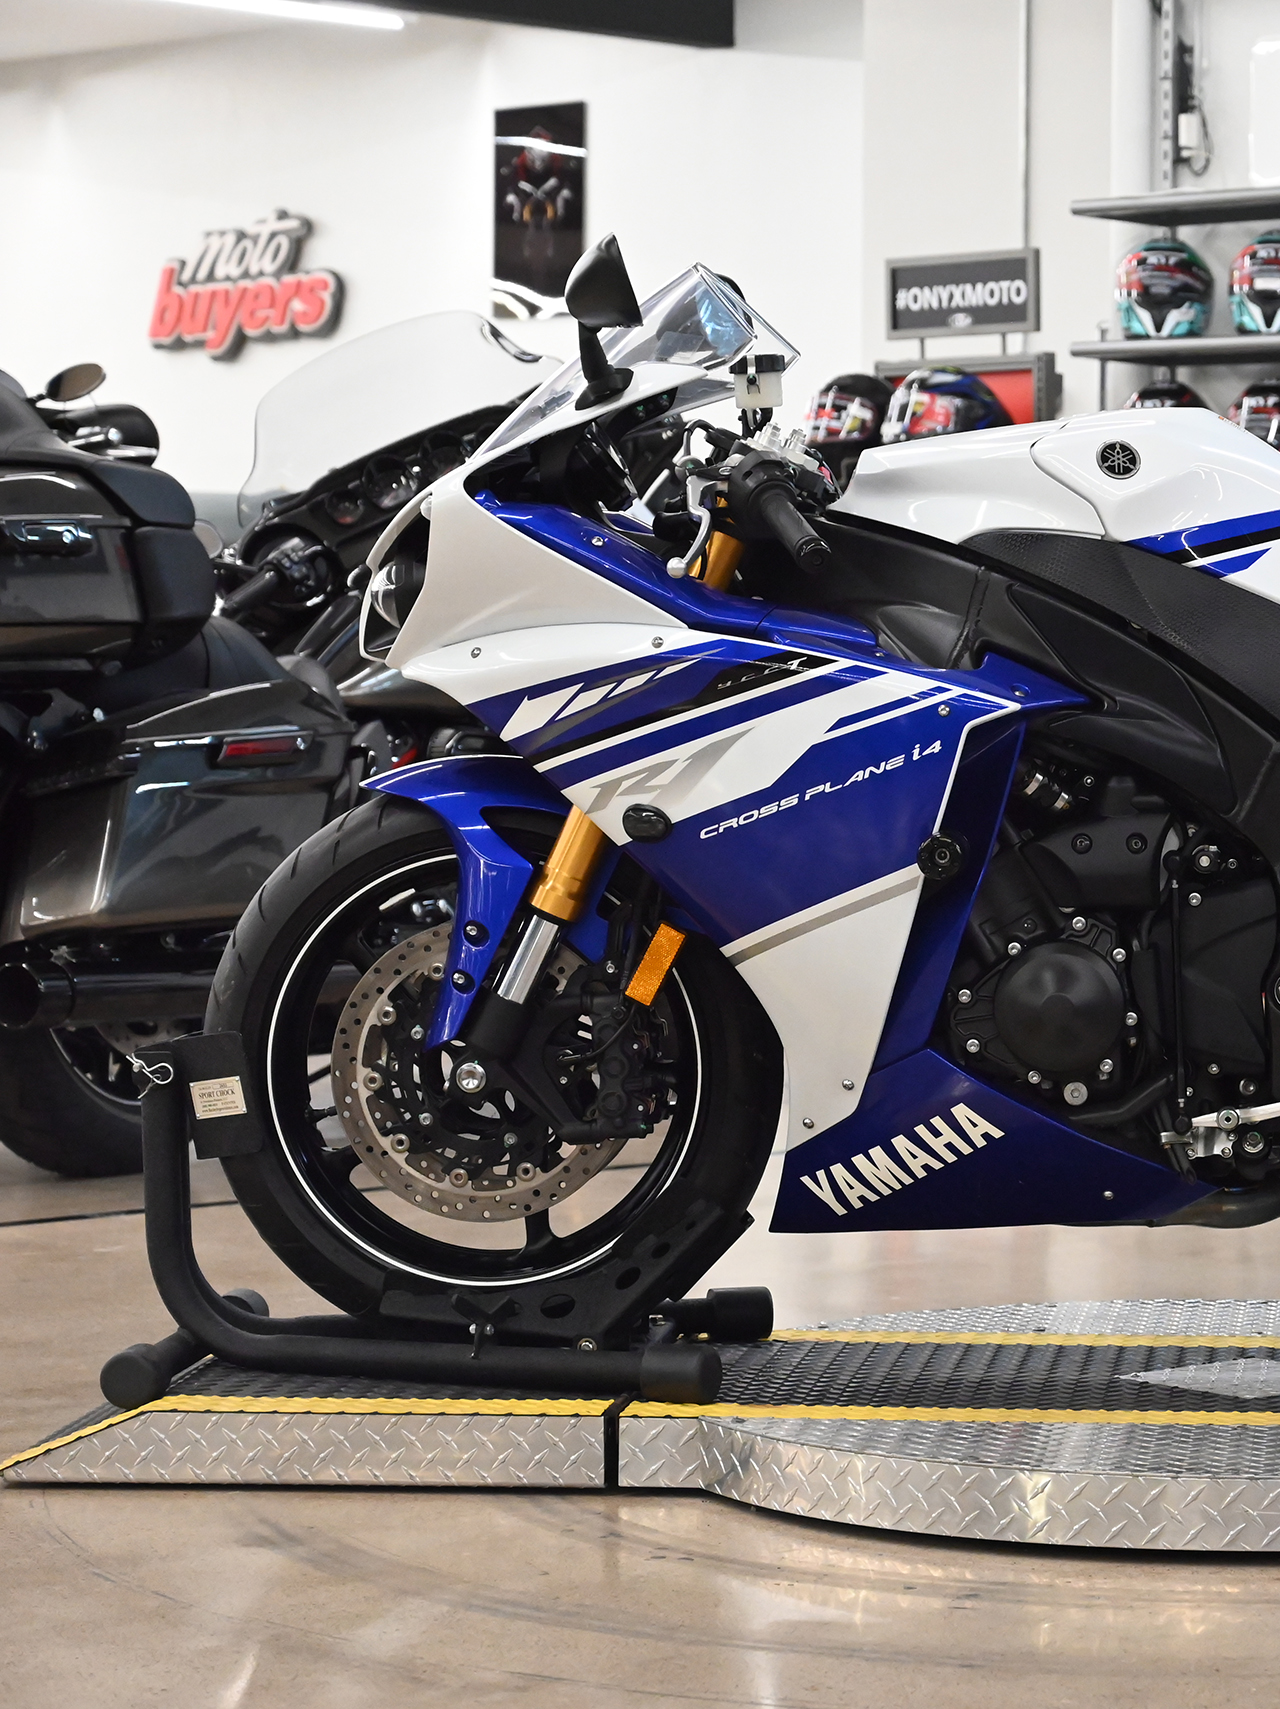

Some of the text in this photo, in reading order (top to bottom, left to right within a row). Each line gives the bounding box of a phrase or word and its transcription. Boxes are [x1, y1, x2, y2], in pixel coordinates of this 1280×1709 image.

[149, 264, 331, 351] buyers
[896, 279, 1027, 312] #ONYXMOTO
[584, 726, 757, 816] R1
[700, 740, 943, 840] CROSS PLANE i4
[800, 1102, 1005, 1216] YAMAHA
